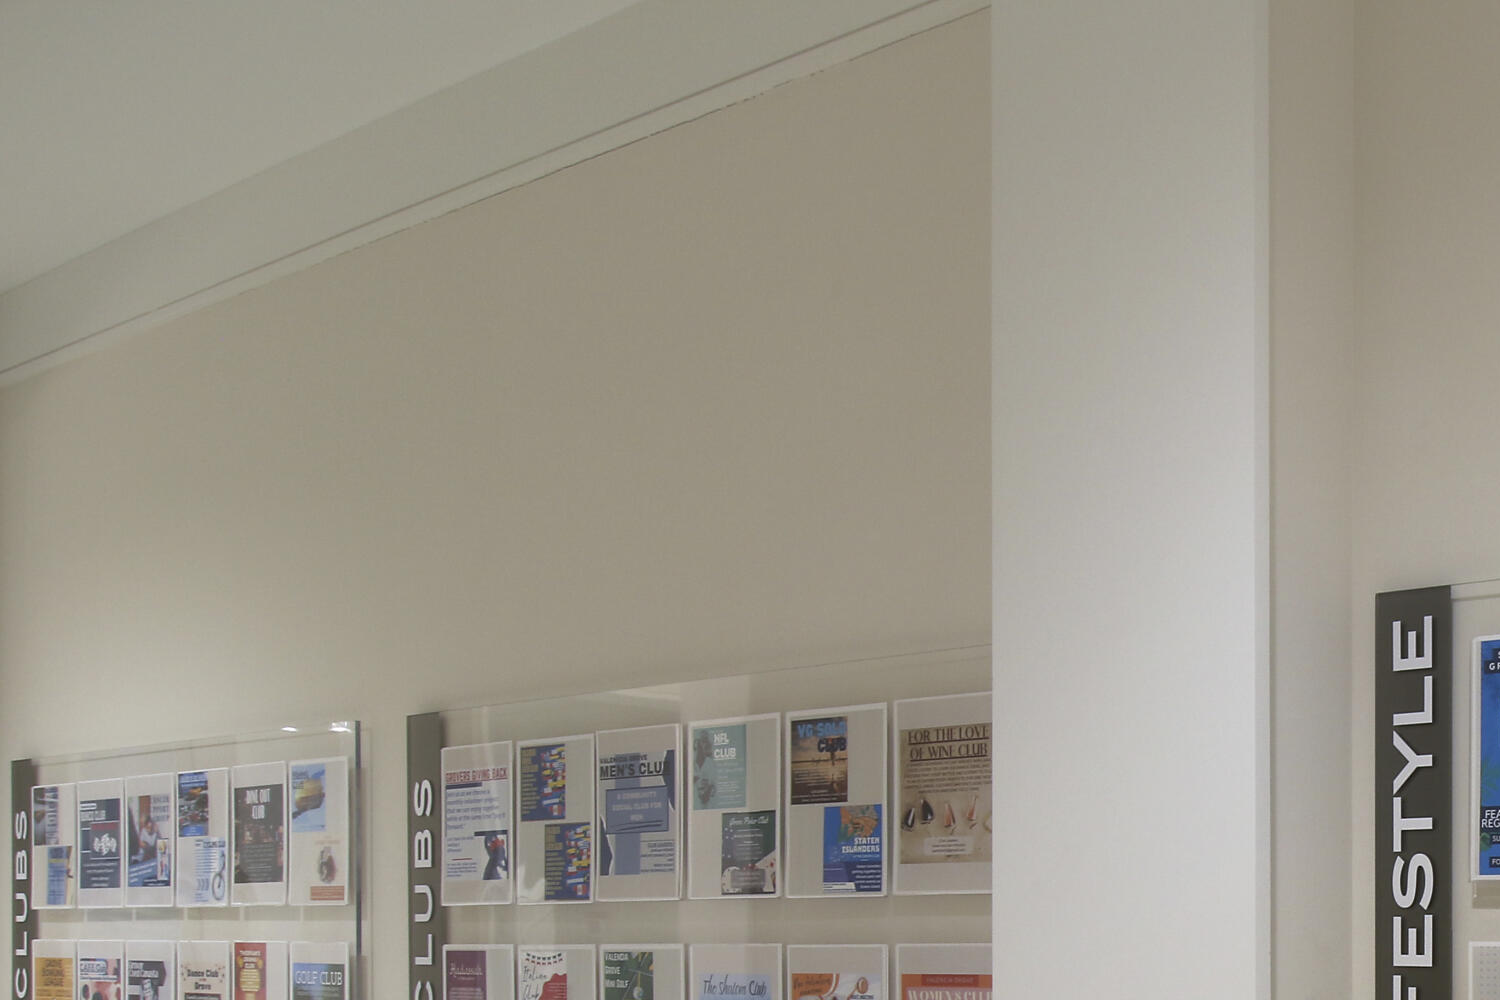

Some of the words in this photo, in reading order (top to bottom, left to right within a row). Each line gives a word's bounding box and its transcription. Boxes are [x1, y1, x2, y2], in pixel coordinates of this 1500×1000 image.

[908, 730, 930, 742] FOR
[936, 728, 953, 740] THE
[714, 748, 736, 758] CLUB
[910, 747, 922, 759] OF
[928, 745, 952, 758] WINE
[958, 743, 987, 755] CLUB
[15, 809, 28, 1000] CLUBS
[321, 972, 342, 985] CLUB
[704, 974, 717, 994] The
